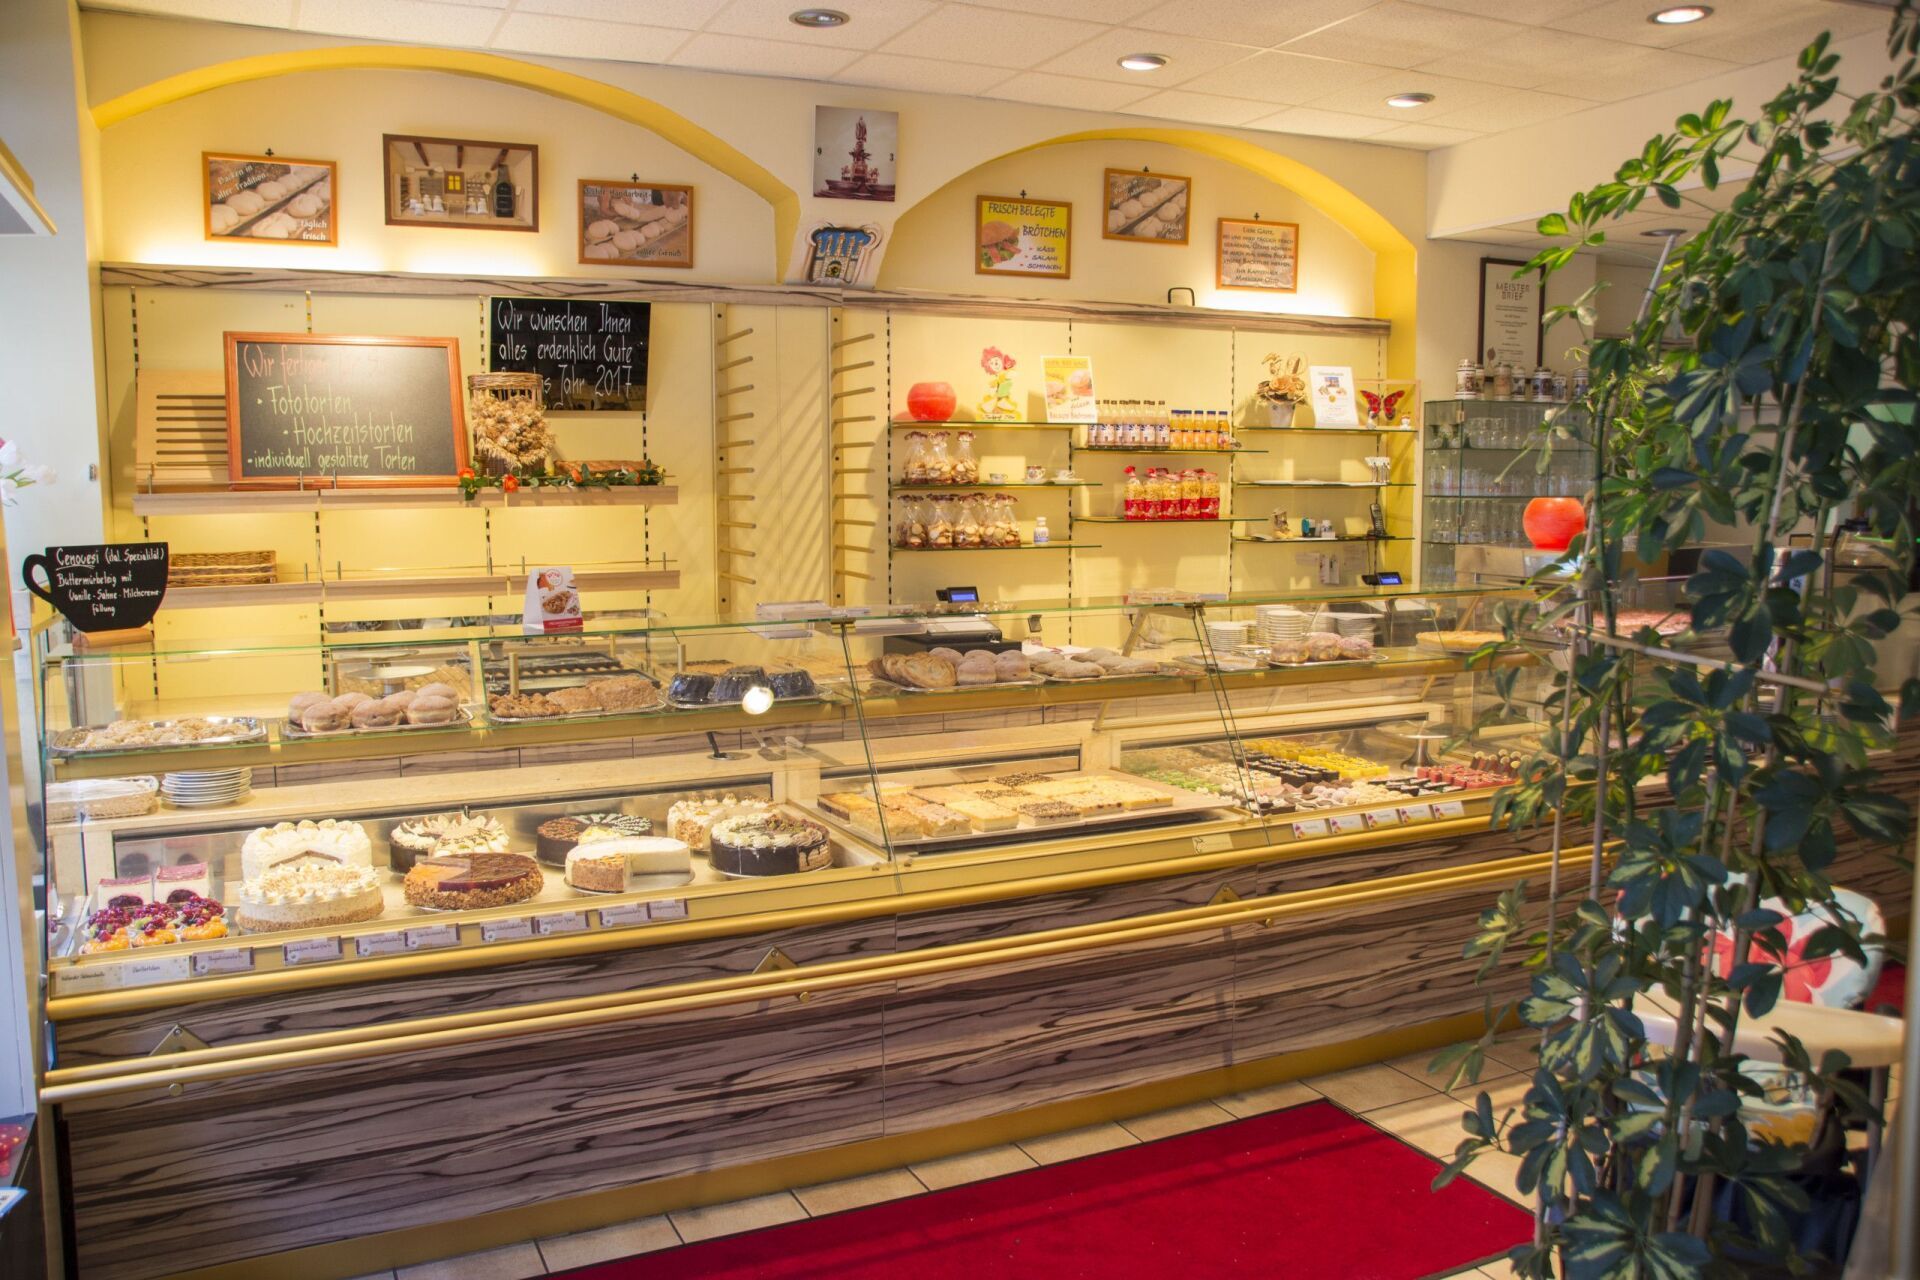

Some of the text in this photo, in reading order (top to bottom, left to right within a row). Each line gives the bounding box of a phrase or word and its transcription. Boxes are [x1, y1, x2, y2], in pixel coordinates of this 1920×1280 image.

[989, 202, 1056, 219] FRISCH BELEGTE
[300, 219, 327, 230] täglich
[1022, 224, 1066, 239] BRÖTCHEN
[302, 232, 326, 240] frisch
[1027, 263, 1062, 271] SCHINKEN
[1496, 282, 1530, 294] MEISTER
[1502, 292, 1524, 301] BRIEF
[498, 300, 631, 333] Wir wünschen Ihnen
[499, 334, 633, 364] alles erdenklich Gute
[243, 345, 275, 378] Wir
[558, 364, 585, 403] Jahr
[594, 365, 633, 399] 2017
[267, 384, 351, 416] Fototorten
[293, 411, 413, 445] Hochzeitstorten
[254, 445, 416, 476] individuell gestaltete Torten
[56, 570, 132, 588] Buttermürbeteig mit
